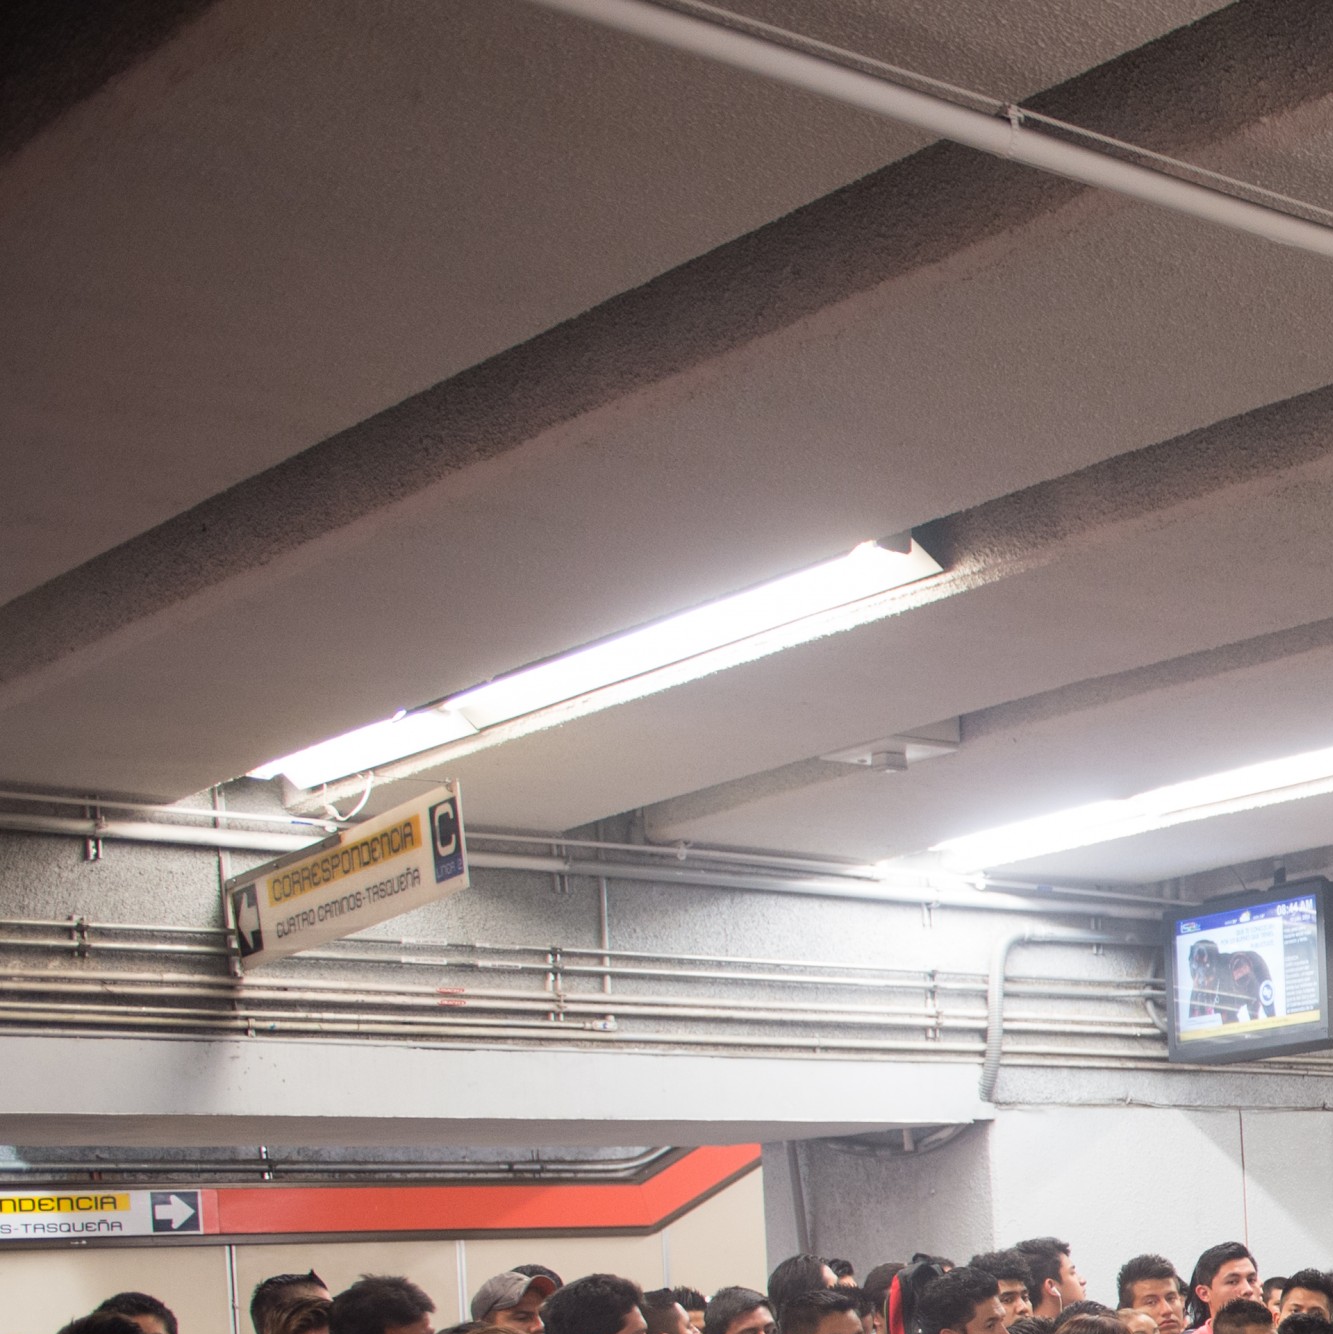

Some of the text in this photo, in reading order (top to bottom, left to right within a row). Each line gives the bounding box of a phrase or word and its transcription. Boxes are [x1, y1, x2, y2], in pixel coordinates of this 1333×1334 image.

[434, 801, 457, 857] C
[271, 820, 416, 902] CORRESPONDENCIA
[275, 912, 315, 939] CUATRO
